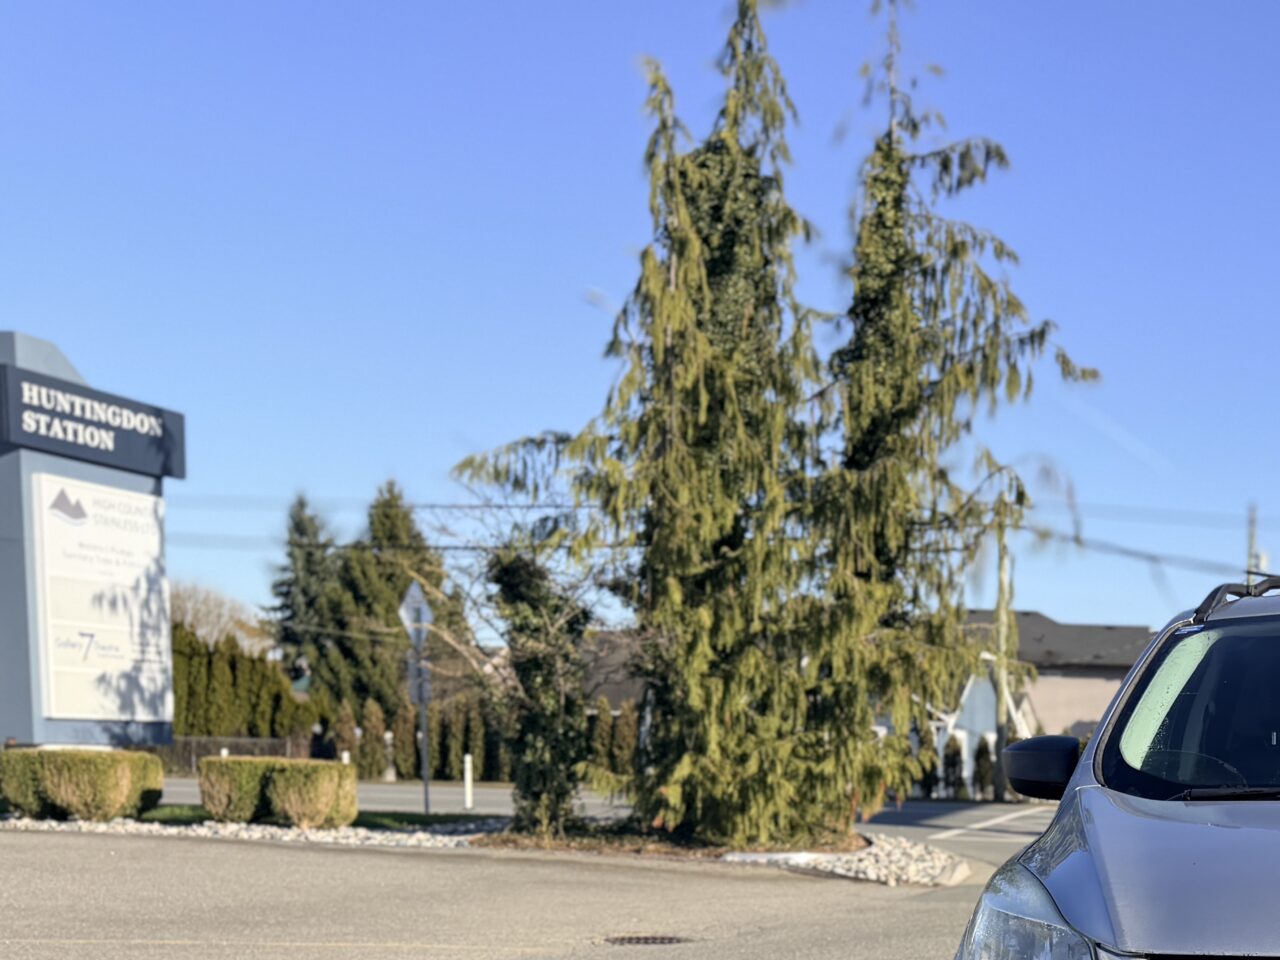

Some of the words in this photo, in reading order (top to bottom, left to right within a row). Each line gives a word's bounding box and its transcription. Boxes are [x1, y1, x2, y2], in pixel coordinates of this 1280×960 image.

[20, 381, 163, 437] HUNTINGDON
[21, 409, 115, 452] STATION
[78, 632, 96, 664] 7
